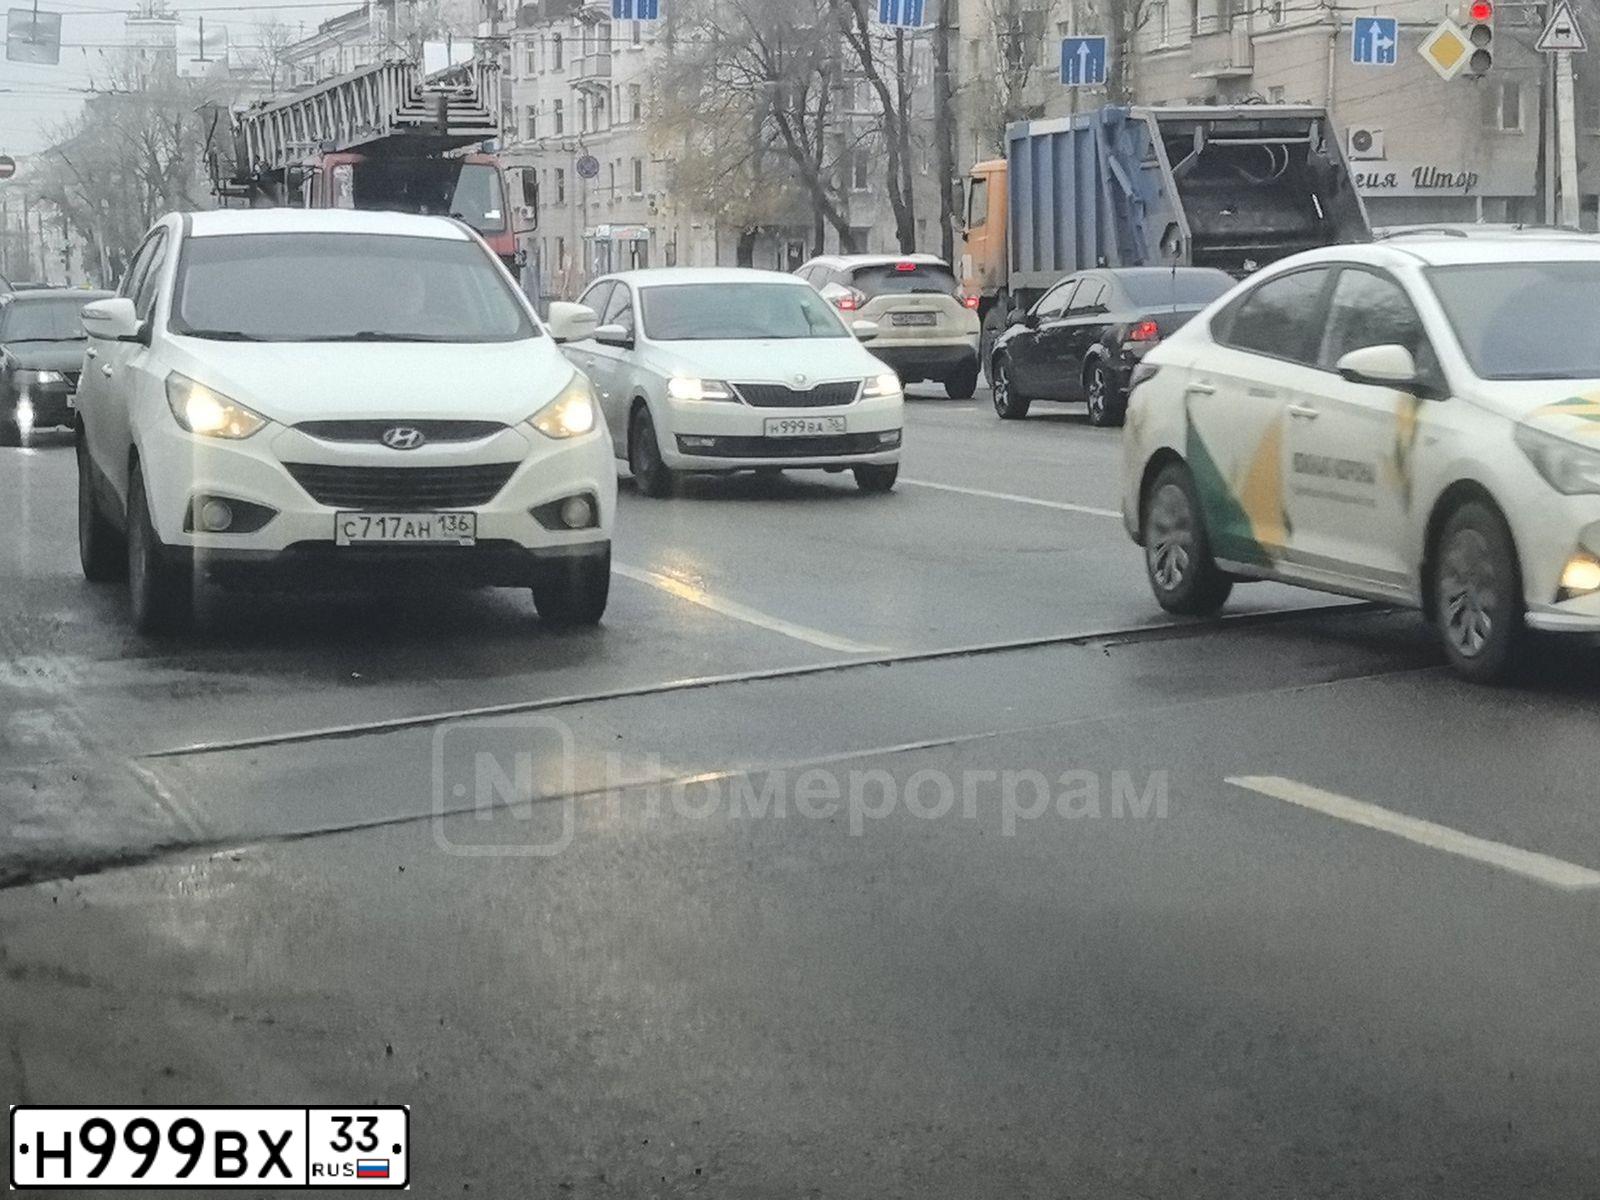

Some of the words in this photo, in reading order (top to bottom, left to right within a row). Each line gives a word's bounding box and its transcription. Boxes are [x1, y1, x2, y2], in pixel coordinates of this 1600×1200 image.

[1412, 166, 1480, 195] Штор
[343, 516, 431, 538] С717АН
[438, 515, 470, 532] 136
